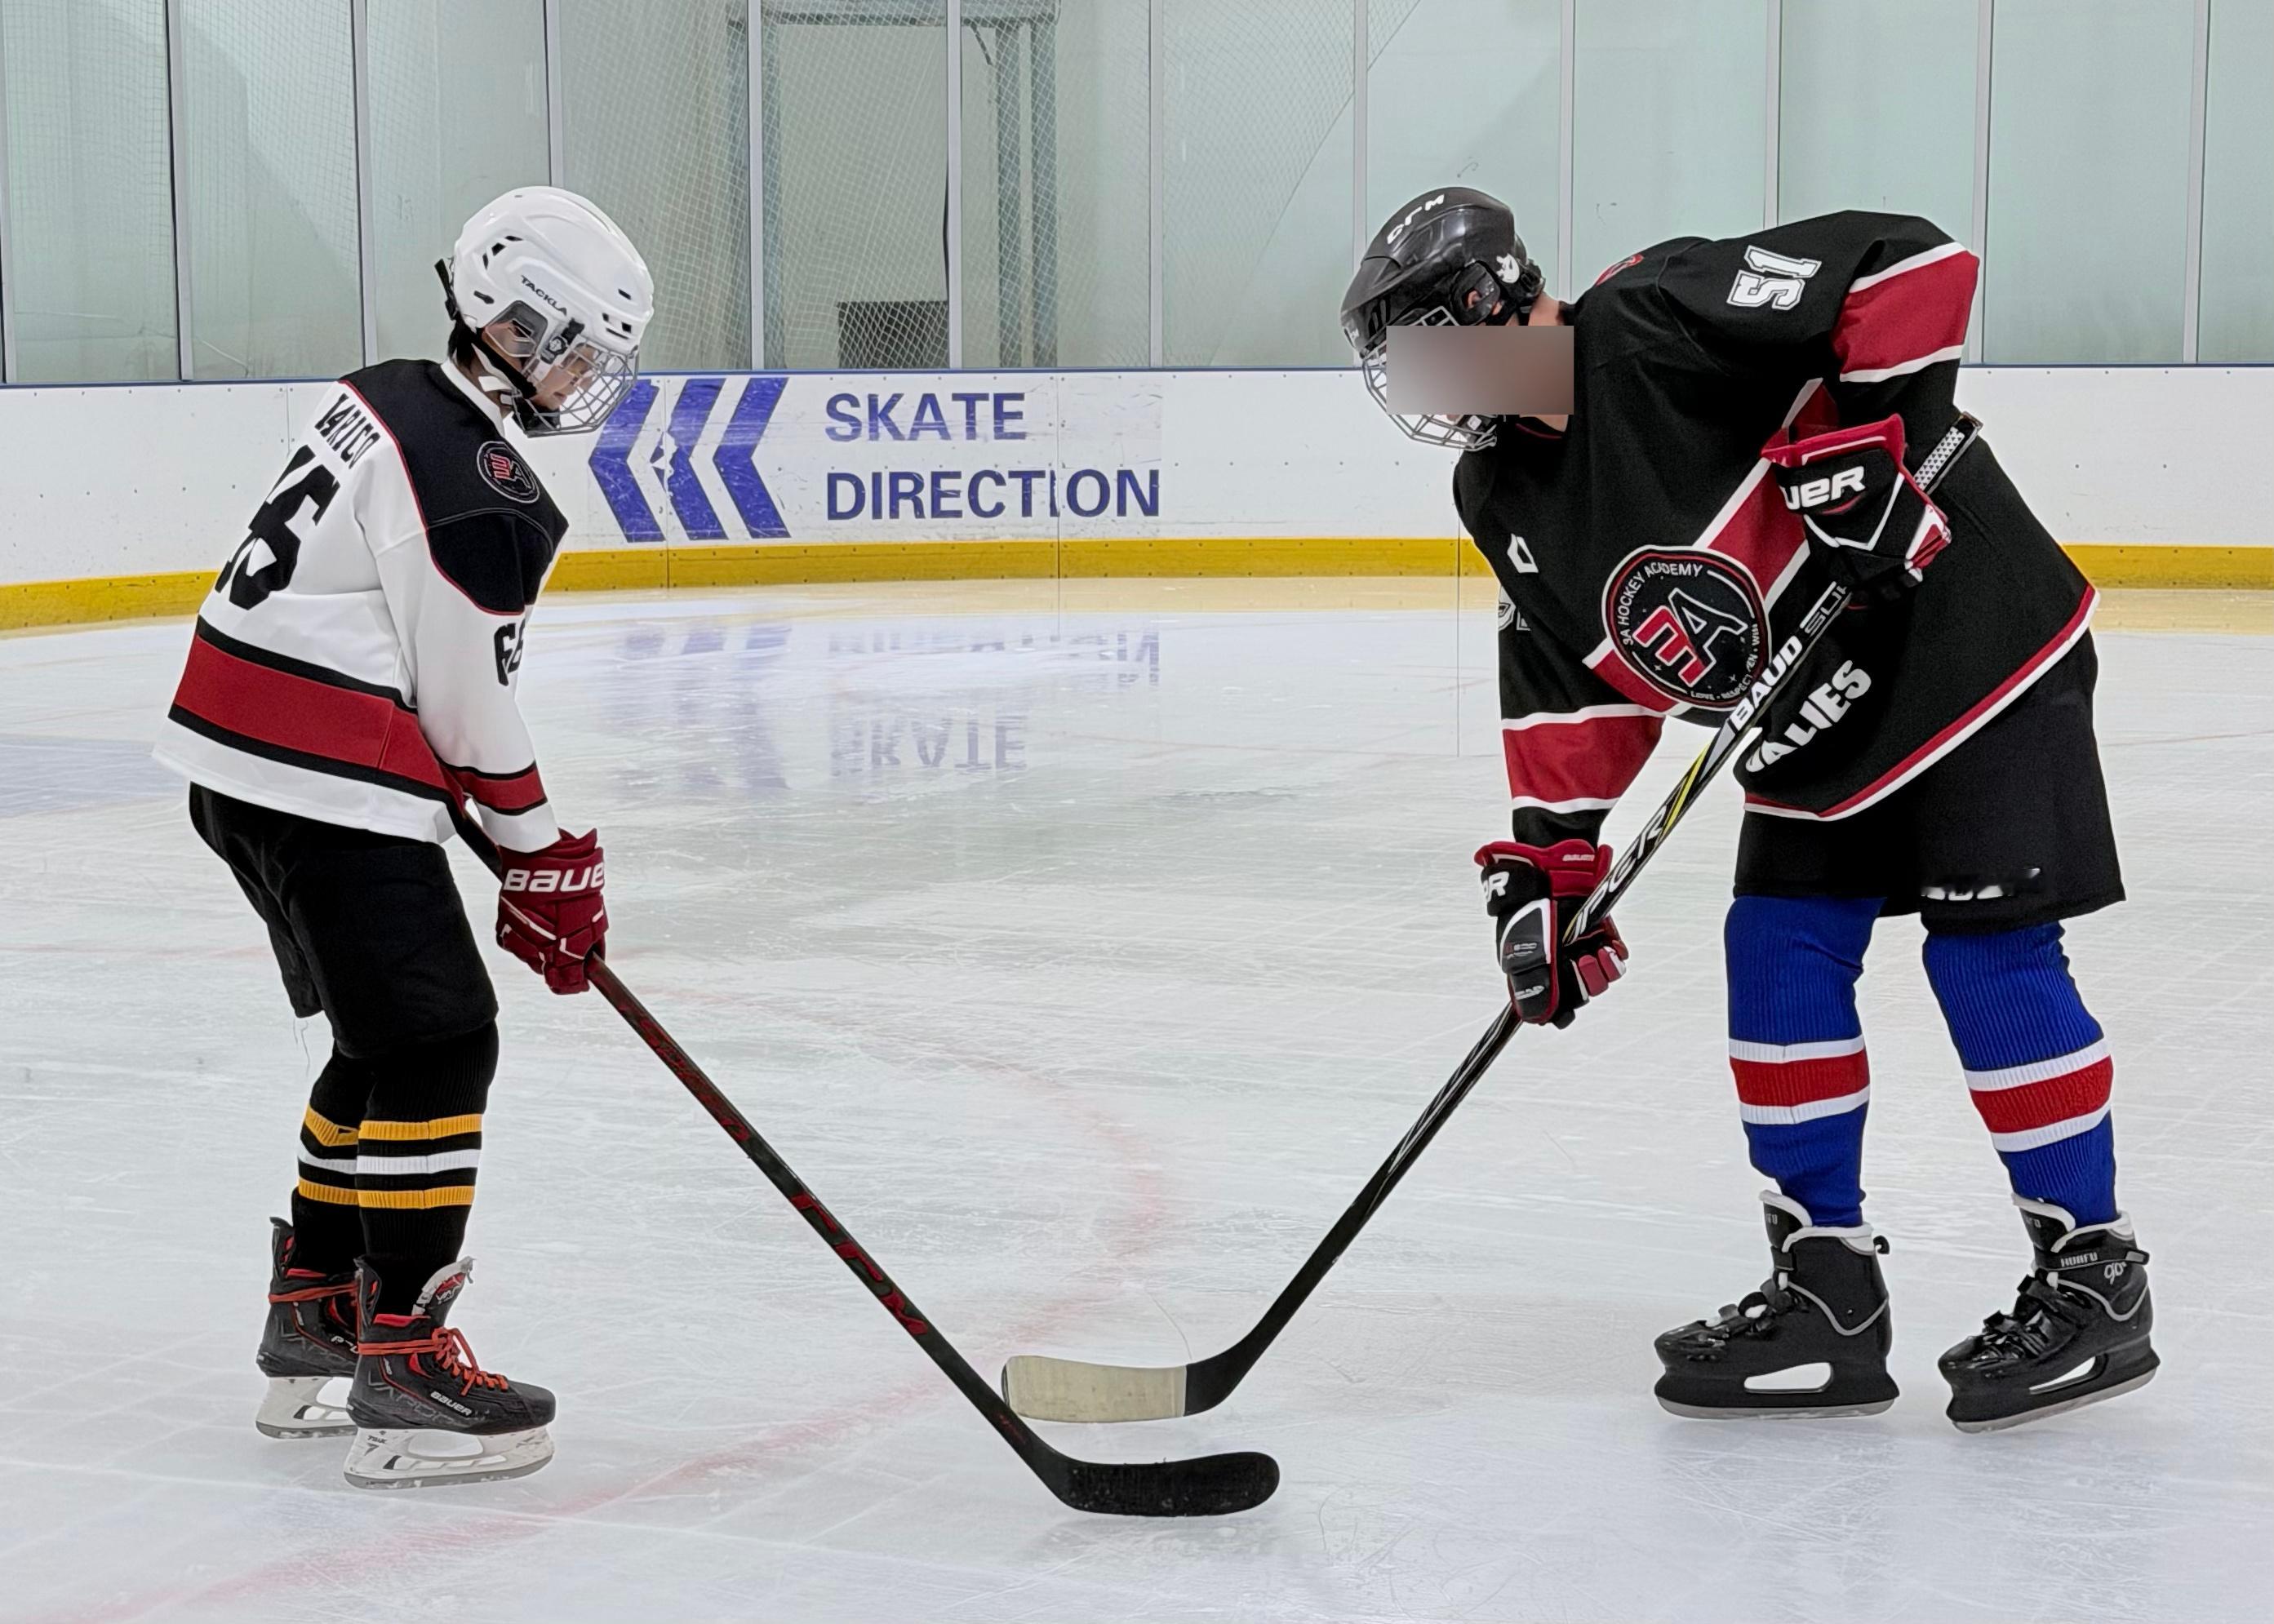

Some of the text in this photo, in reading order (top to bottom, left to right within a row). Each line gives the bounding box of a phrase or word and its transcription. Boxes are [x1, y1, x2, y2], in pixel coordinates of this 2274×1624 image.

[521, 274, 567, 317] TACKLA
[1726, 245, 1822, 311] 51
[825, 393, 1027, 441] SKATE
[826, 468, 1161, 521] DIRECTION
[1616, 570, 1646, 626] HOCKEY
[429, 1390, 473, 1418] BAUER
